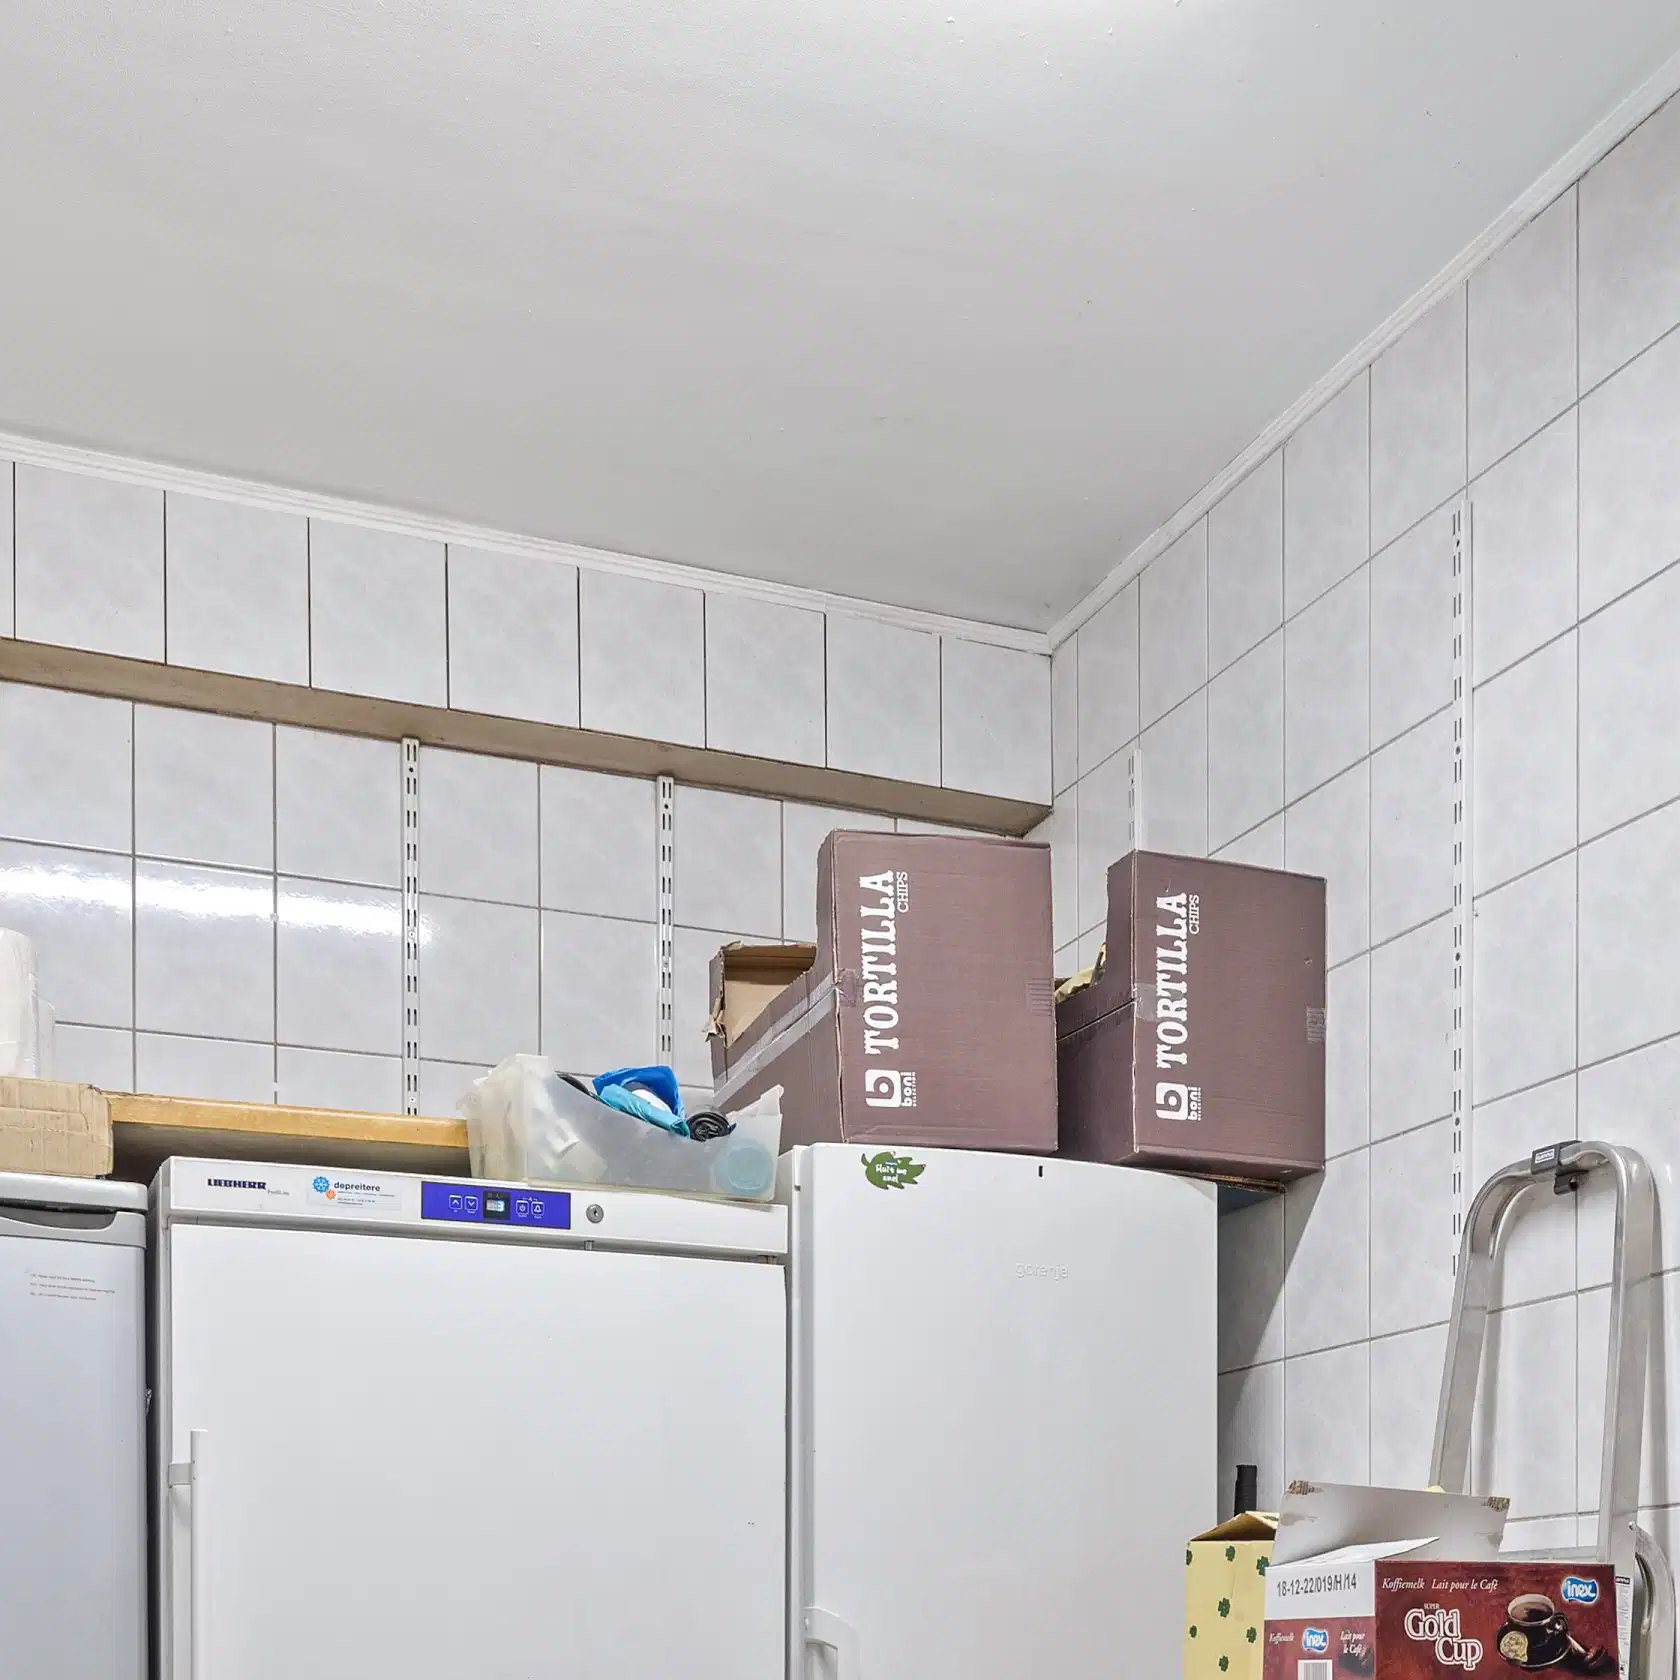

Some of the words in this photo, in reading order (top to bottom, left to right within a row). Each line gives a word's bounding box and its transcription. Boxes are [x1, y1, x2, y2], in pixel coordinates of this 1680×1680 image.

[859, 870, 900, 1056] TORTILLA
[897, 871, 909, 913] CHIPS
[1156, 892, 1188, 1069] TORTILLA
[1188, 894, 1200, 936] CHIPS
[899, 1071, 912, 1108] boni
[1187, 1086, 1198, 1121] boni
[207, 1178, 267, 1190] LIEBHERR
[333, 1181, 381, 1193] depreitere
[1381, 1577, 1425, 1592] Koffiemelk
[1431, 1578, 1449, 1590] Lait
[1449, 1580, 1470, 1593] pour
[1470, 1579, 1479, 1590] le
[1567, 1580, 1595, 1598] inex
[1305, 1631, 1326, 1648] inex
[1404, 1608, 1462, 1641] Gold
[1435, 1637, 1484, 1671] Cup
